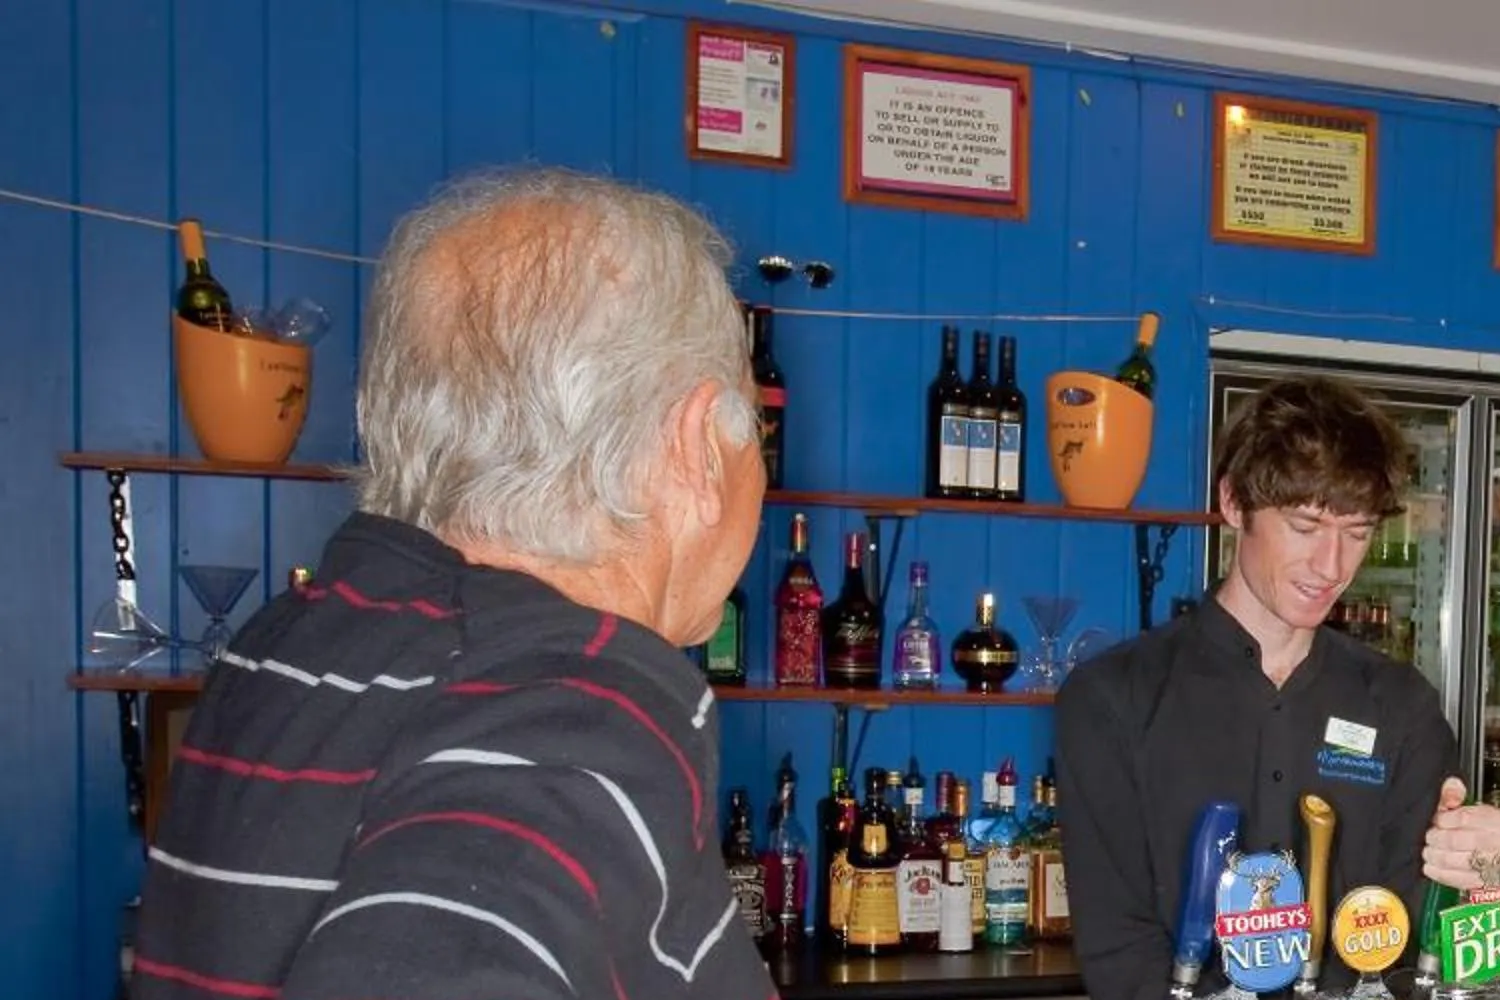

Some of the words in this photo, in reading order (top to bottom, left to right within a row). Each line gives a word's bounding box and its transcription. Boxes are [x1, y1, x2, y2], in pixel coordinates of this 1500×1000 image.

[1224, 908, 1307, 934] TOOHEYS
[1354, 911, 1390, 929] XXXX
[1221, 933, 1312, 973] NEW
[1344, 926, 1401, 954] GOLD
